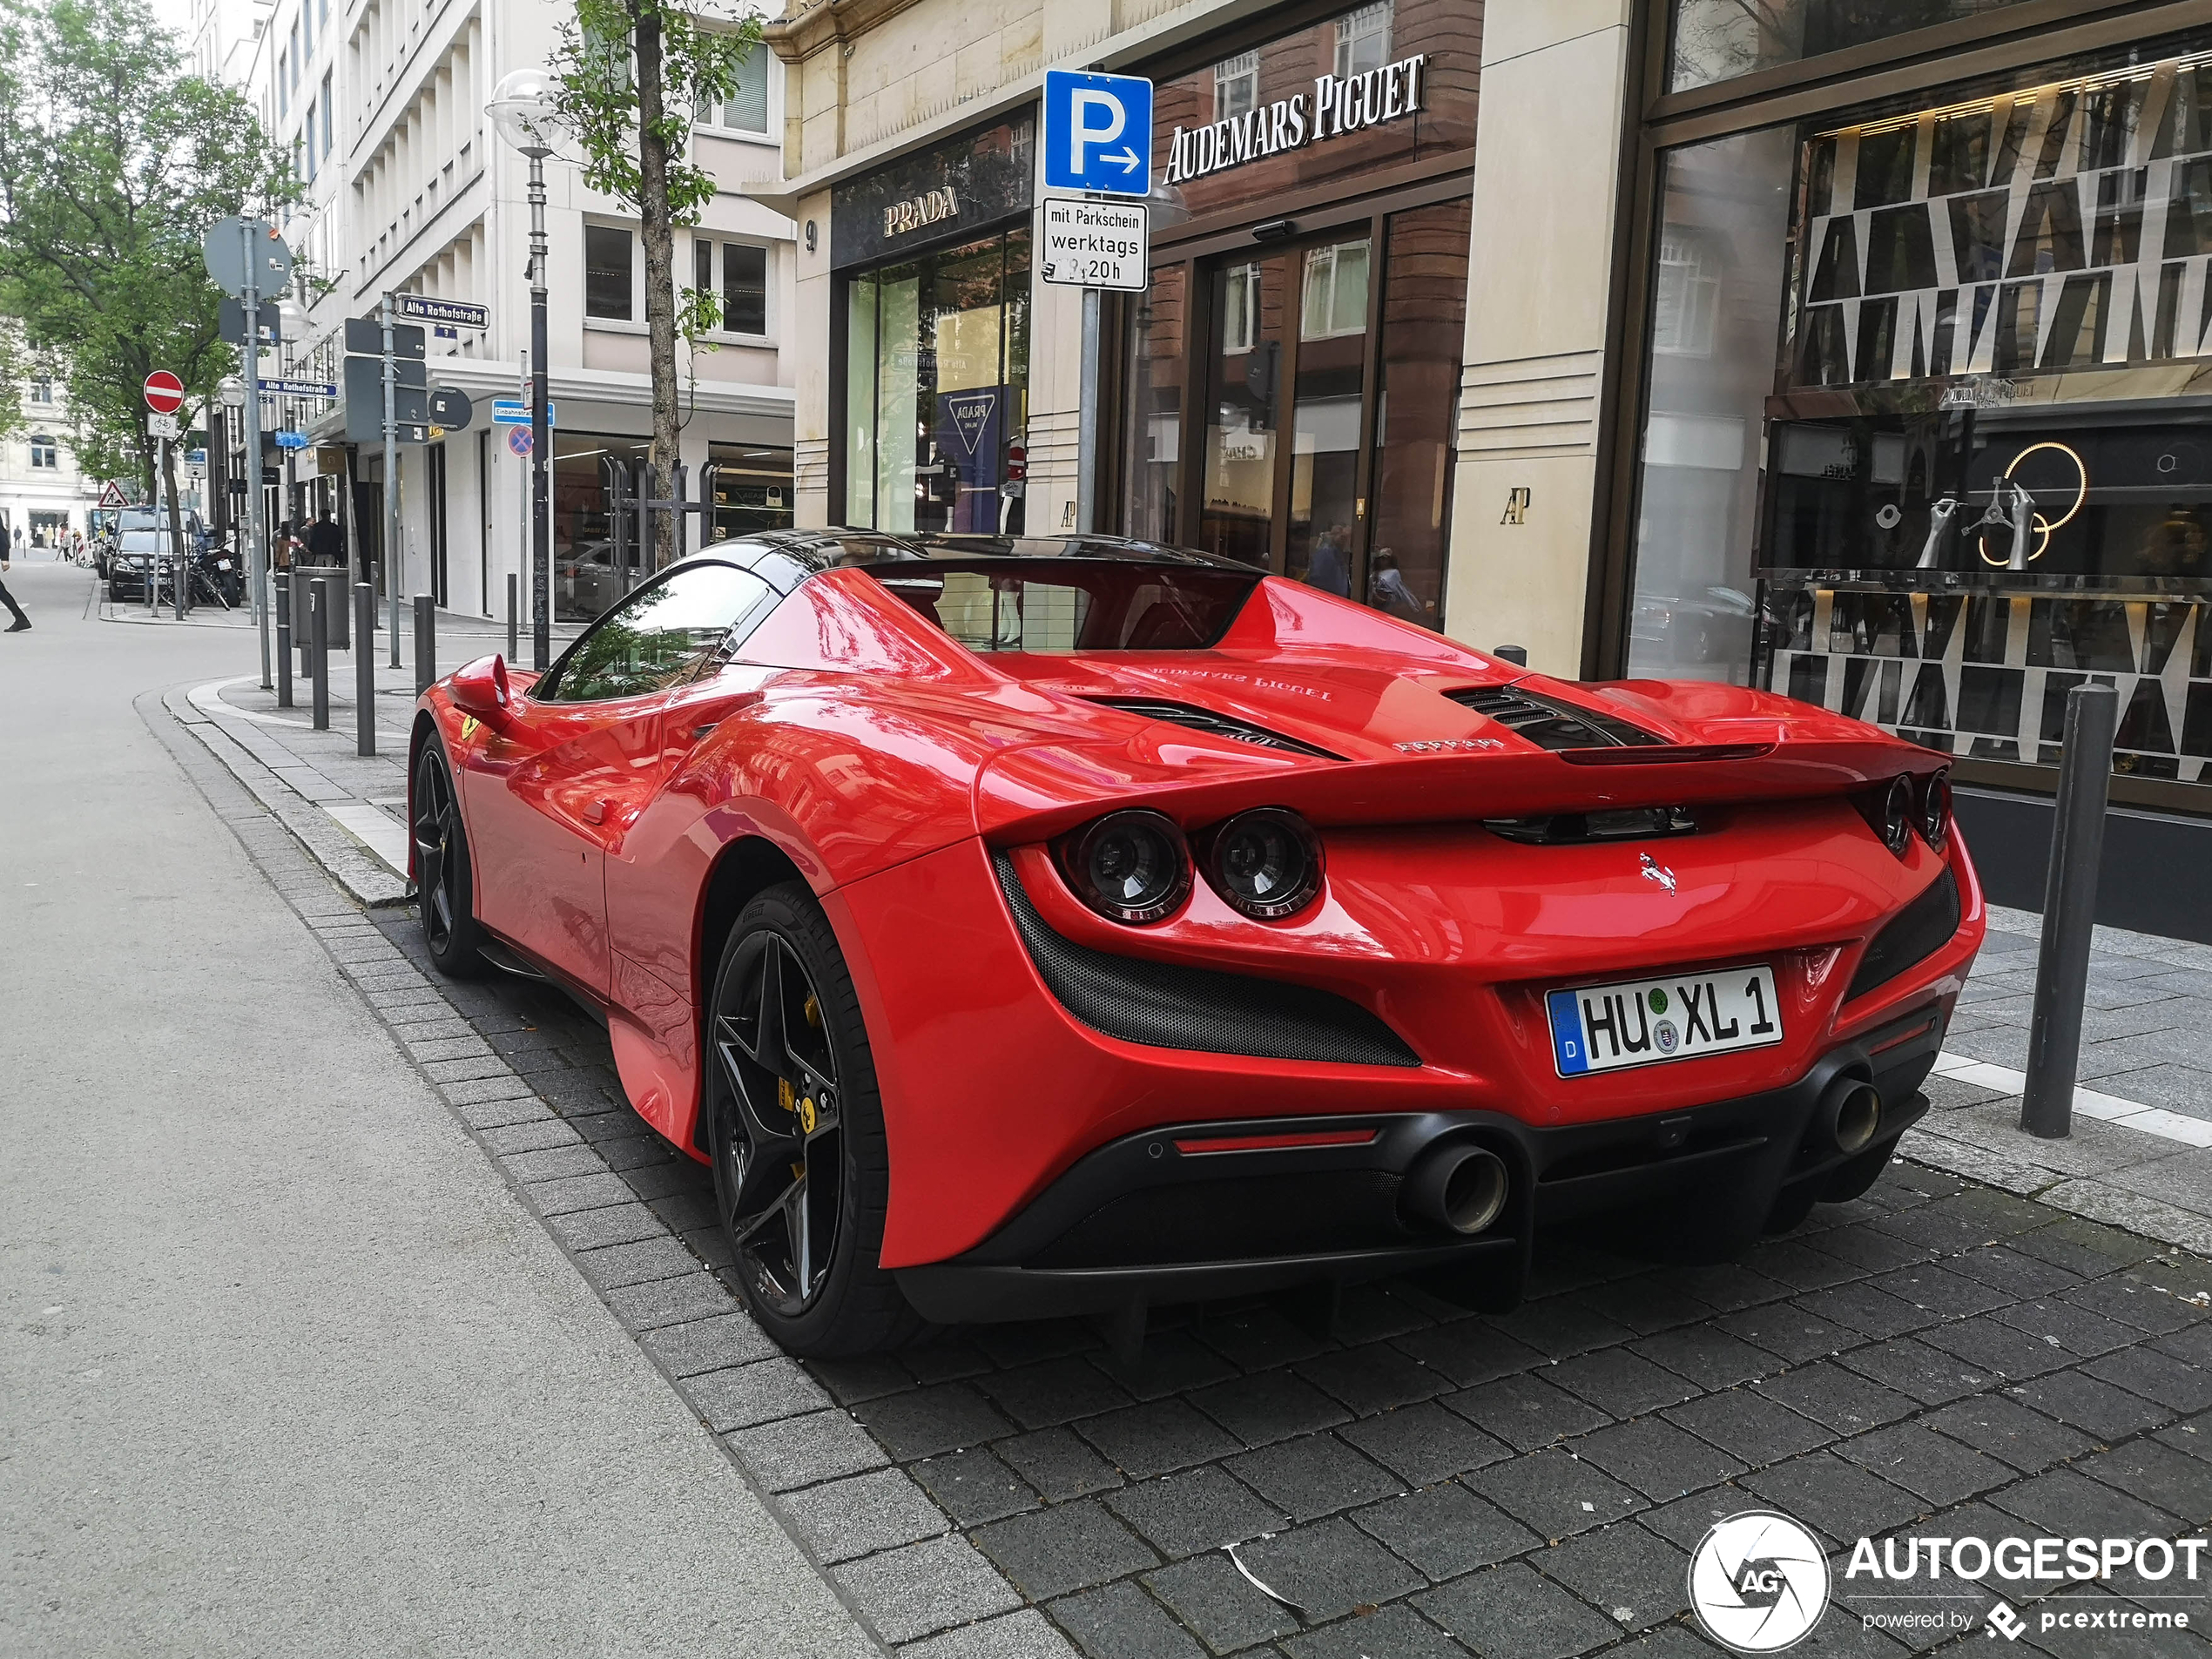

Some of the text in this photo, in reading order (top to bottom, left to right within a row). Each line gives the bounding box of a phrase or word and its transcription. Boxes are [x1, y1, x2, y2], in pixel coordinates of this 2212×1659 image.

[1070, 87, 1126, 175] P
[1162, 53, 1425, 185] AUDEMARS PIGUET
[883, 185, 960, 238] PRADA
[1051, 208, 1139, 229] mit Parkschein
[806, 219, 818, 252] 9
[1051, 233, 1138, 259] werktags
[406, 301, 482, 322] Alte Rothofstraße
[266, 381, 327, 394] Alte Rothofstraße
[1500, 487, 1531, 524] AP
[1582, 991, 1651, 1060] HU
[1676, 982, 1740, 1046] XL
[1745, 976, 1775, 1035] 1
[1565, 1040, 1577, 1058] D
